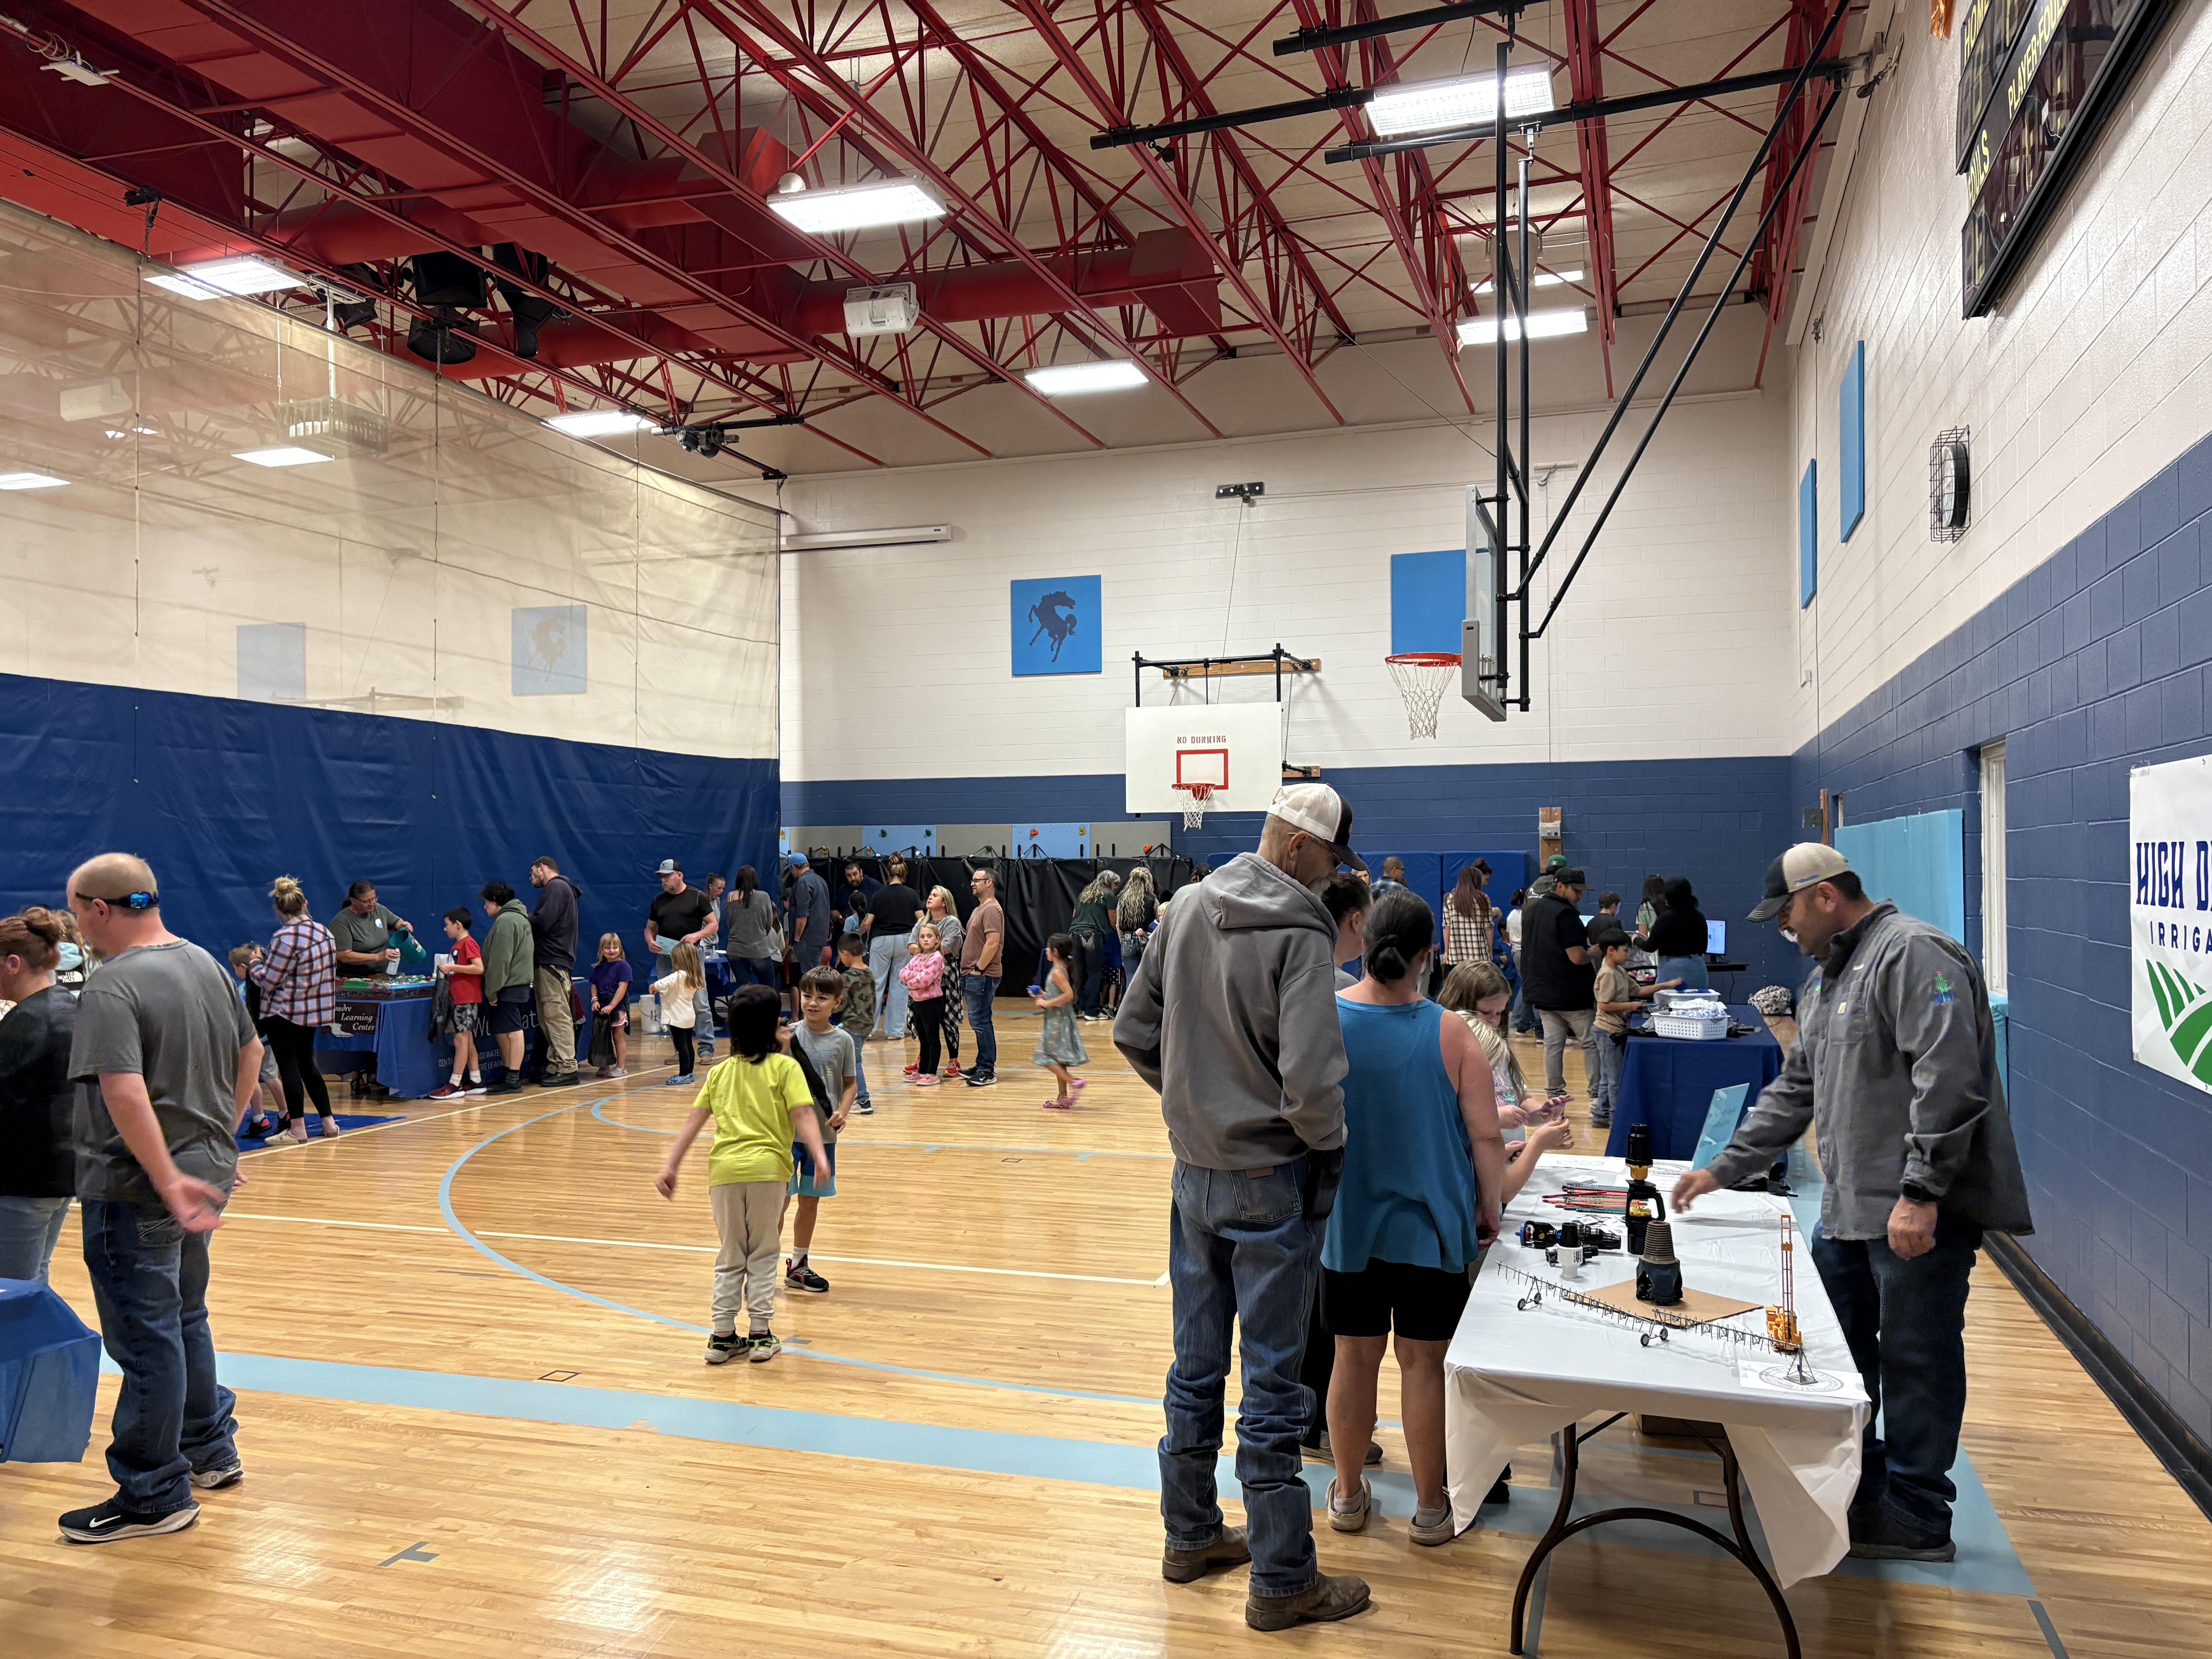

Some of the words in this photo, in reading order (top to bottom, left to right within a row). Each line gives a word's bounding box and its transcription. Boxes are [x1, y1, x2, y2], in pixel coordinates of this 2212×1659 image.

[1968, 129, 1989, 211] FOULS
[1191, 735, 1226, 744] DUNKING
[2136, 842, 2185, 908] HIGH
[2196, 841, 2212, 912] D
[341, 1013, 373, 1023] Learning
[352, 1022, 374, 1030] Center
